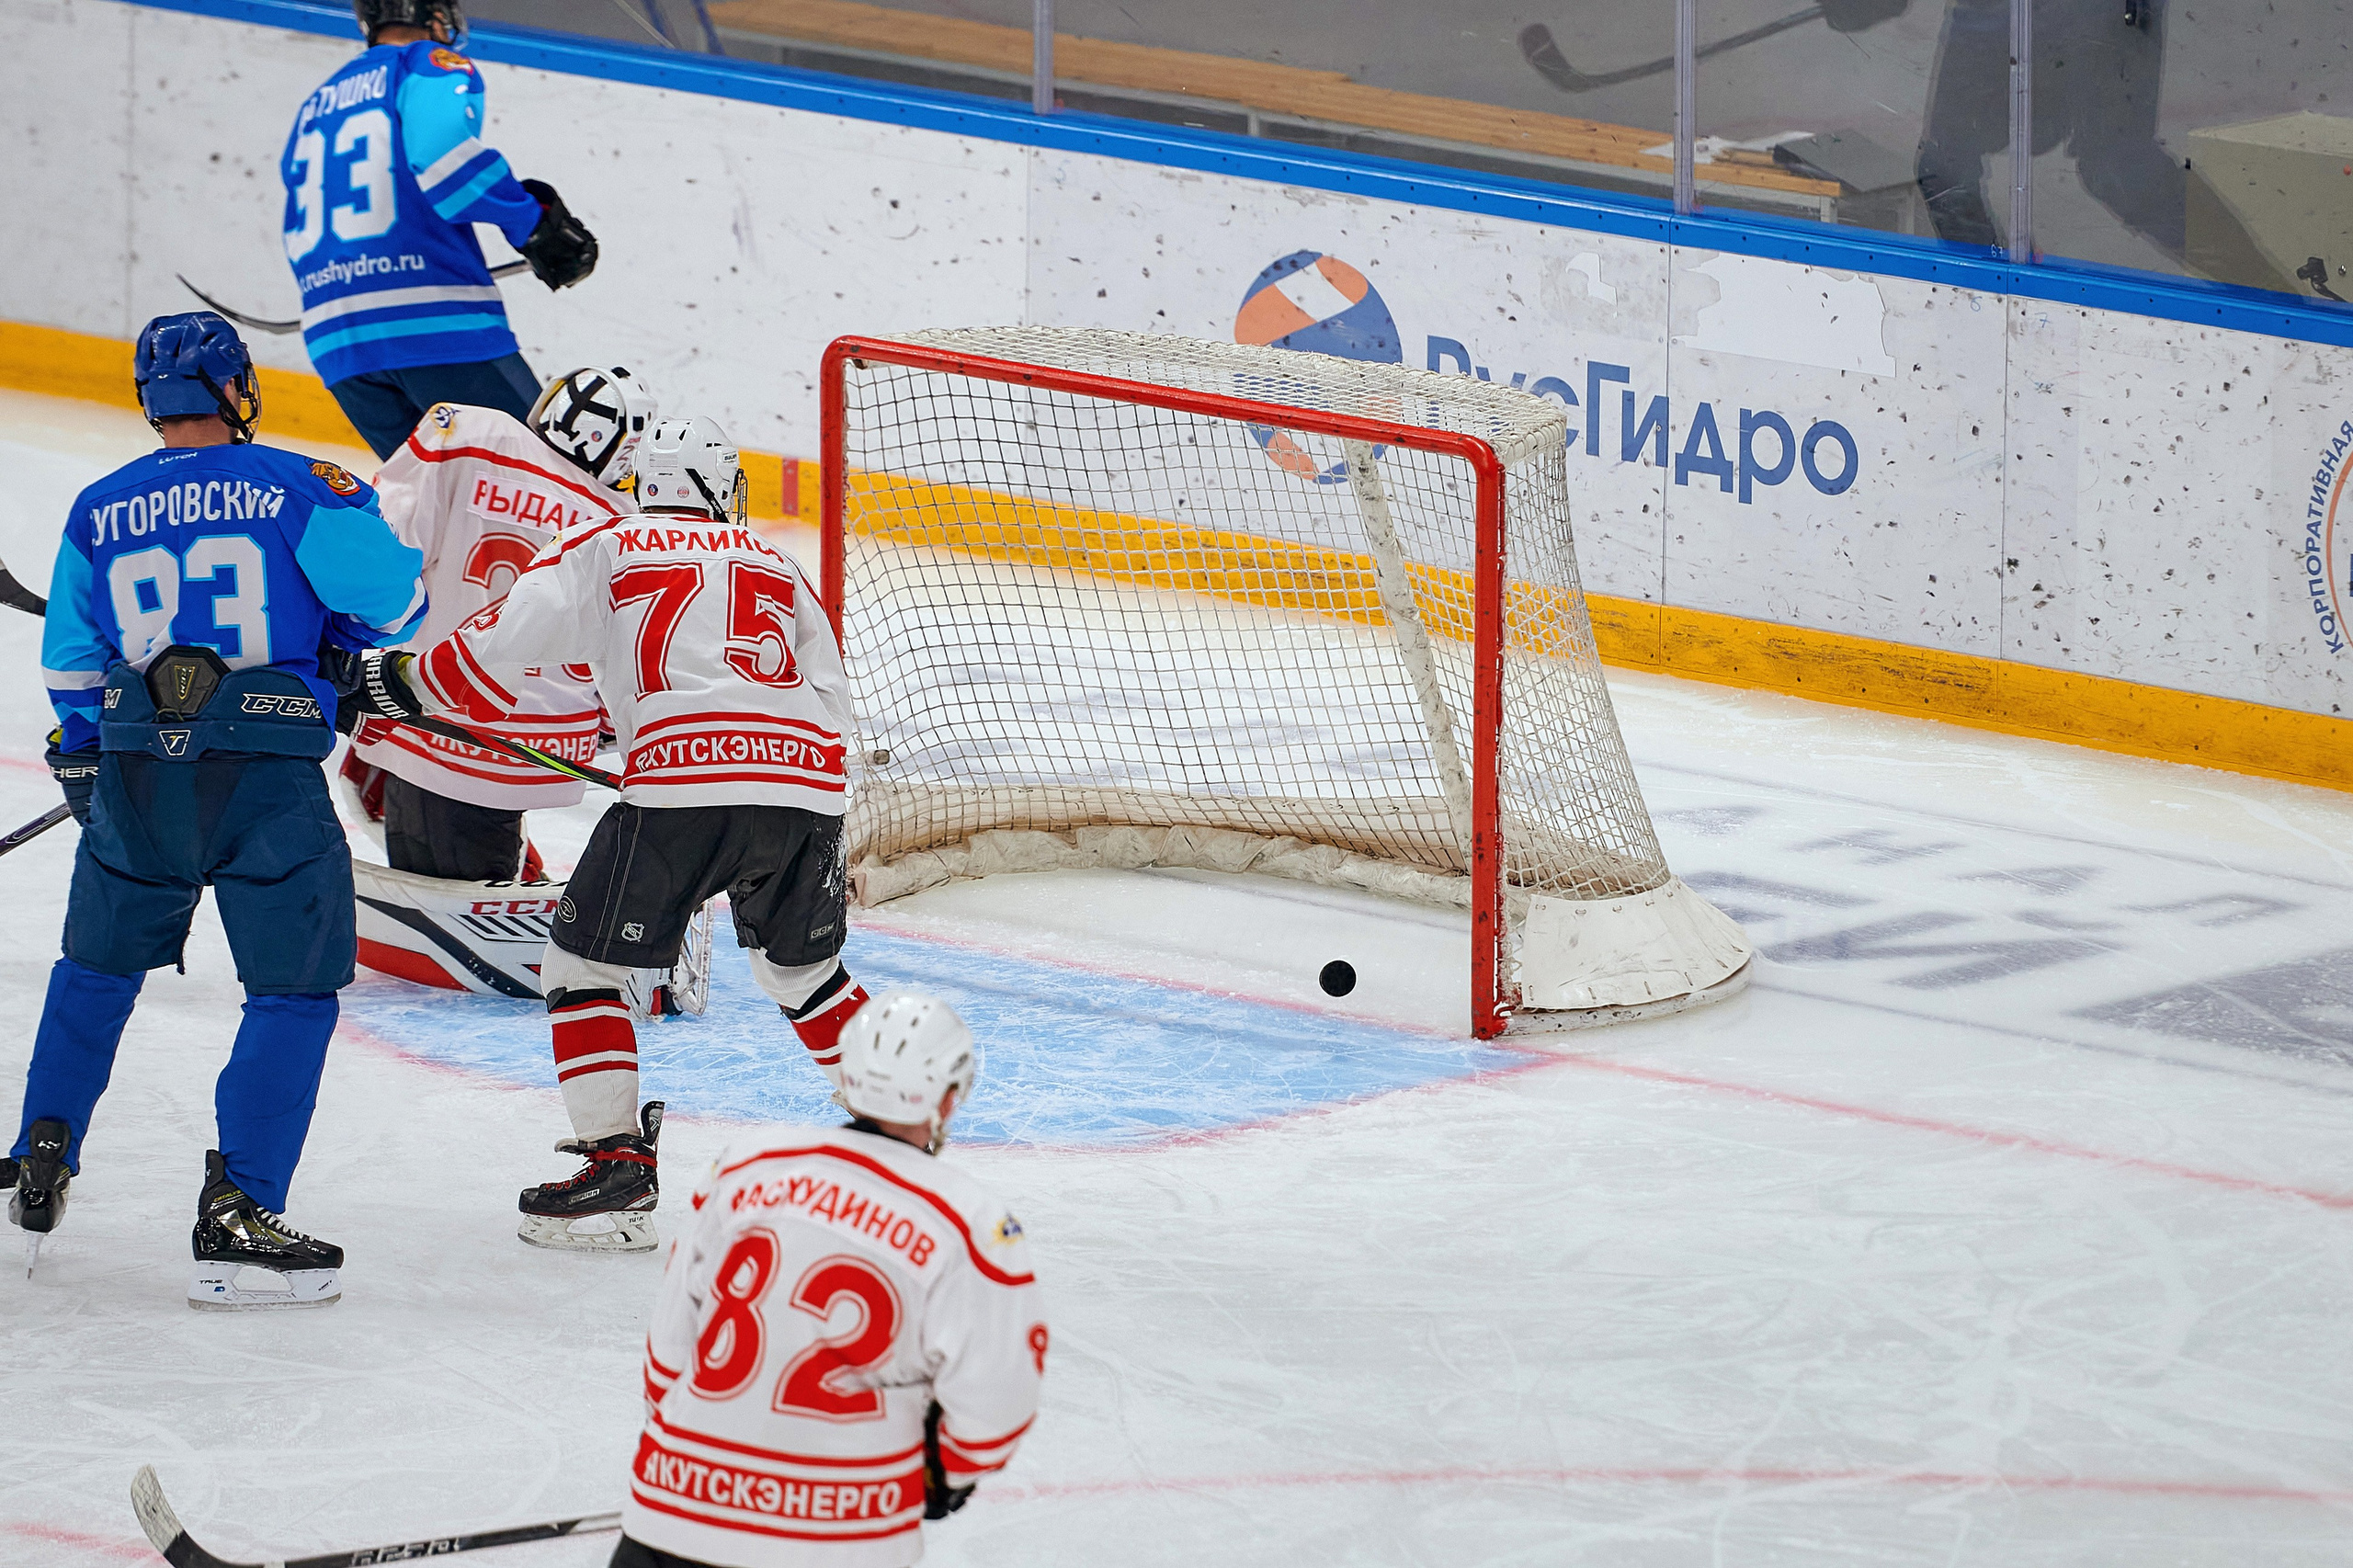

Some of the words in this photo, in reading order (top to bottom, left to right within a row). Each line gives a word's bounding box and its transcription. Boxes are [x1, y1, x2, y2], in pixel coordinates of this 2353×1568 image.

[283, 106, 397, 265] 33
[90, 481, 285, 546] УГОРОВСКИЙ
[2305, 420, 2353, 653] КОРПОРАТИВНАЯ
[108, 533, 271, 674] 83
[609, 562, 804, 703] 75
[365, 655, 410, 720] ARRIOR
[635, 735, 825, 773] ЯКУТСКЭНЕРГО
[689, 1224, 904, 1423] 82
[643, 1450, 904, 1519] ЯКУТСКЭНЕРГО
